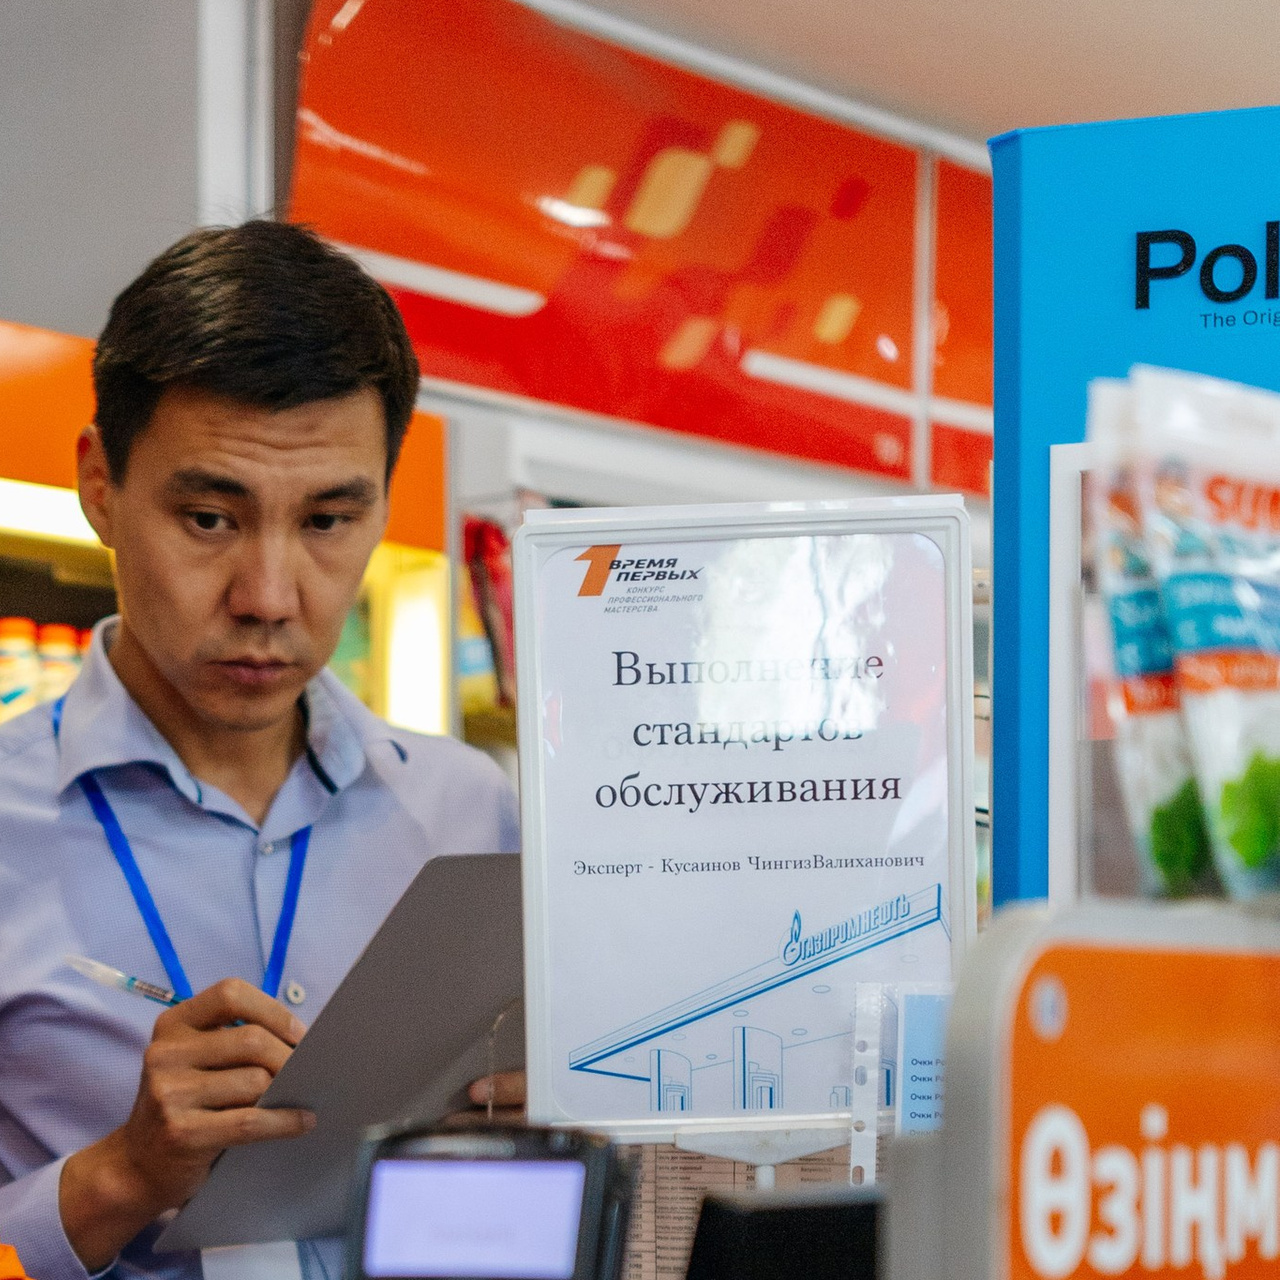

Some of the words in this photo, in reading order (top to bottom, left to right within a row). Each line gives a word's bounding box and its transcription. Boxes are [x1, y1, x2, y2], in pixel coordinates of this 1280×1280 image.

[1135, 220, 1280, 310] Pol
[1200, 312, 1237, 329] The
[608, 557, 678, 570] ВРЕМЯ
[615, 567, 705, 582] ПЕРВЫХ
[626, 585, 666, 594] КОНКУРС
[607, 594, 704, 604] ПРОФЕССИОНАЛЬНОГО
[603, 605, 658, 614] МАСТЕРСТВА
[633, 717, 864, 752] стандартов
[595, 771, 902, 814] обслуживания
[573, 859, 642, 878] Эксперт
[661, 857, 741, 876] Кусаинов
[911, 1058, 932, 1066] Очки
[910, 1074, 932, 1082] Очки
[910, 1093, 932, 1101] Очки
[909, 1111, 932, 1119] Очки
